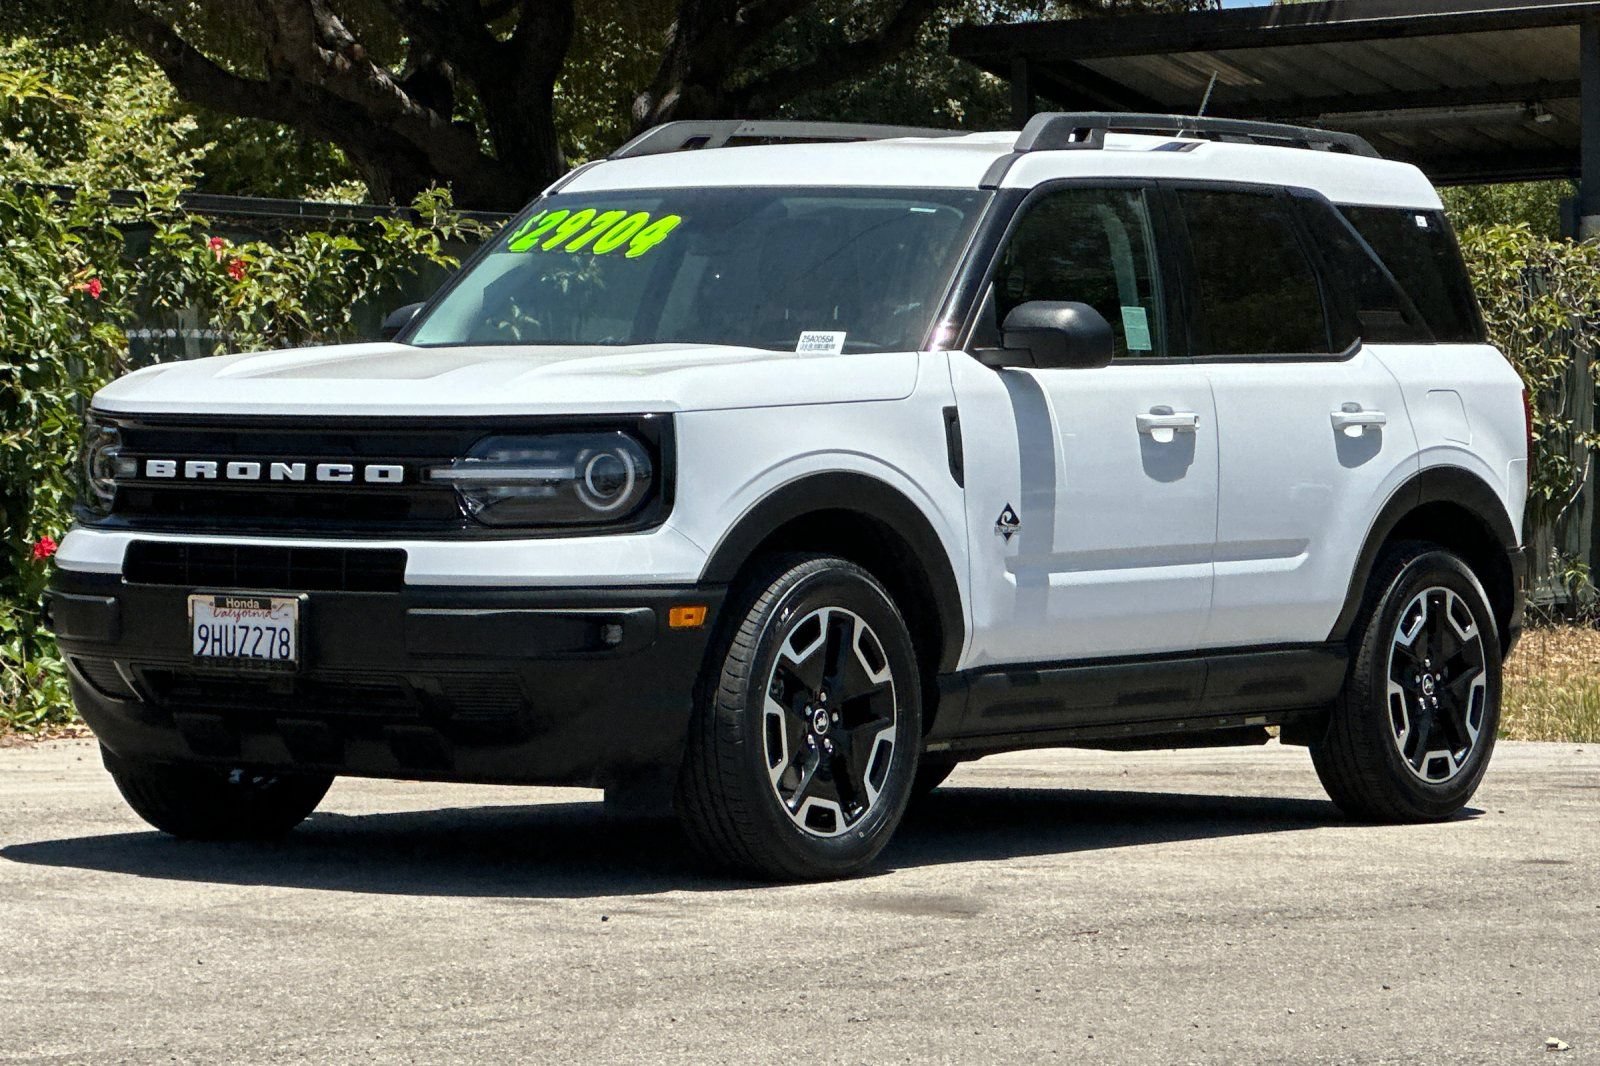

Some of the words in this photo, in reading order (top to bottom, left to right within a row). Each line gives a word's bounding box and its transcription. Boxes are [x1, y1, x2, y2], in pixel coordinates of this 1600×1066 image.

[146, 460, 403, 483] BRONCO
[225, 598, 260, 609] Honda
[197, 623, 291, 660] 9HUZ278
